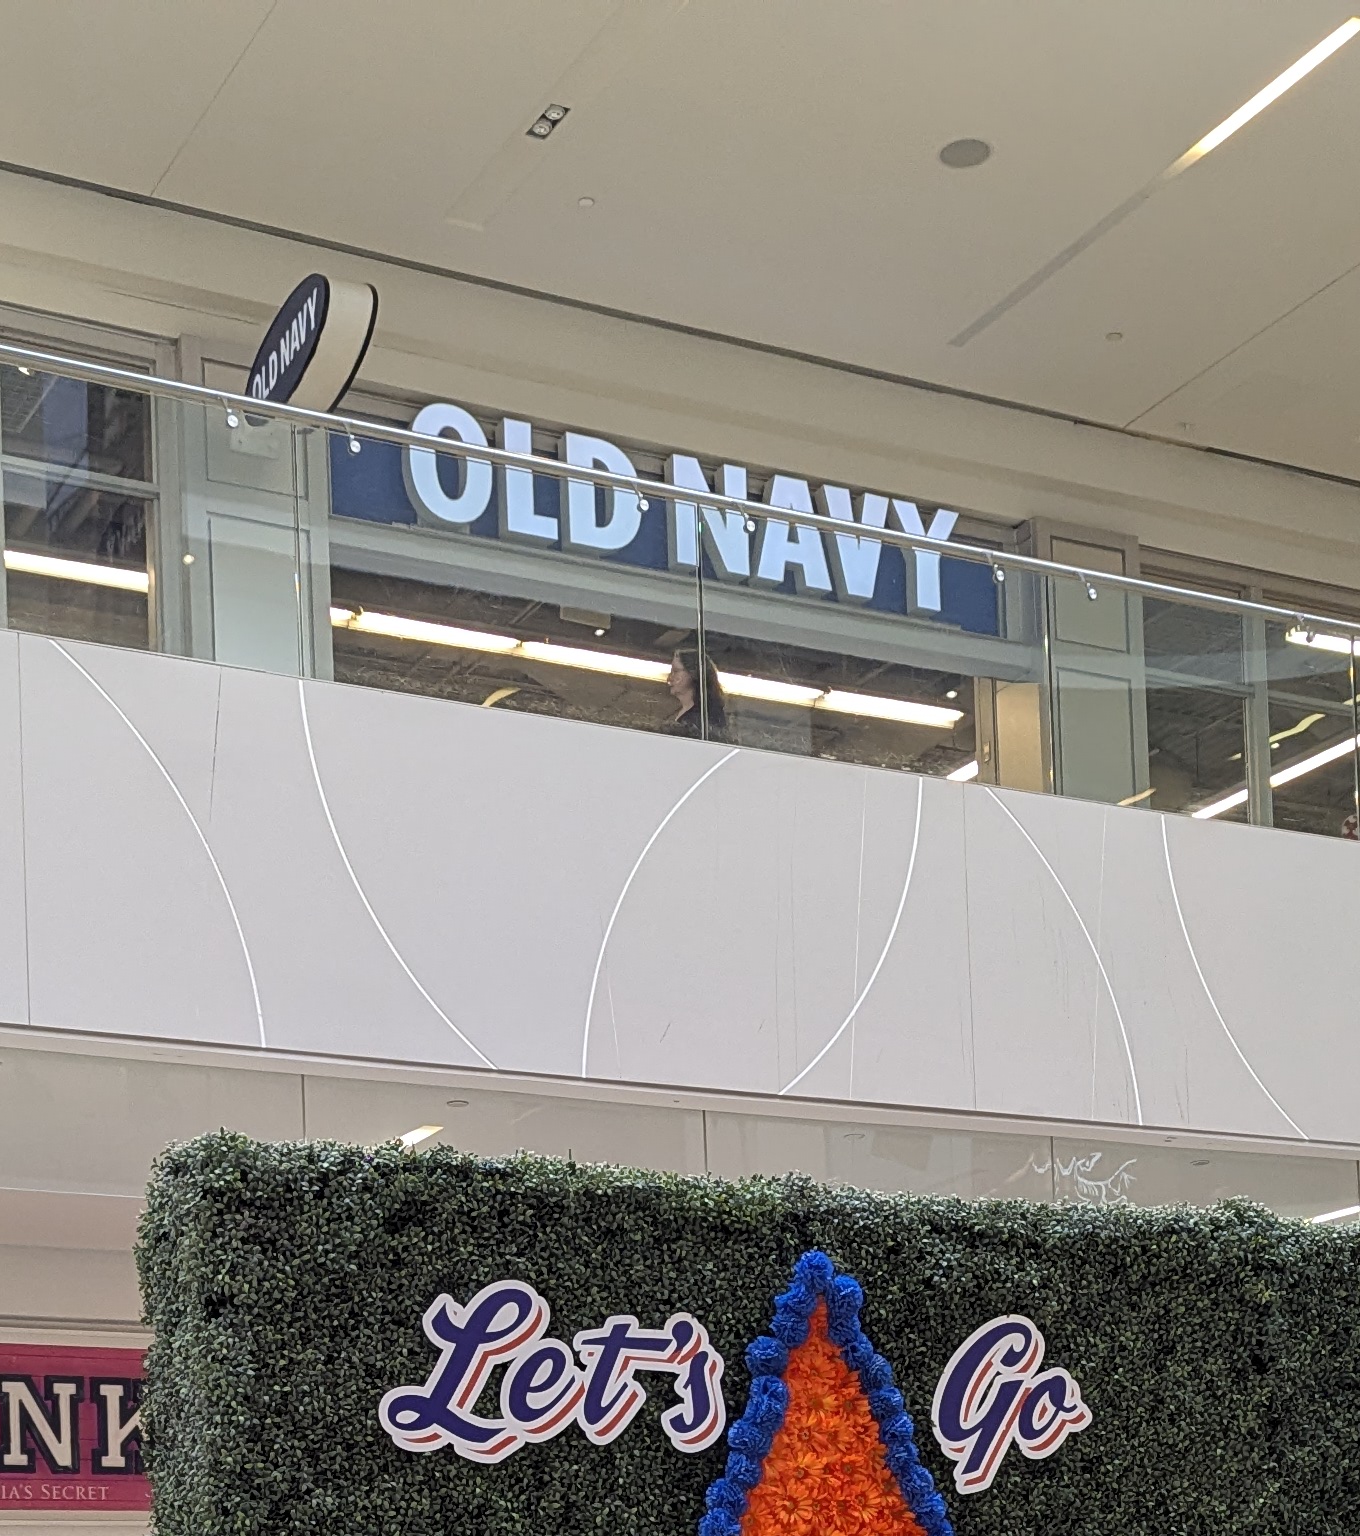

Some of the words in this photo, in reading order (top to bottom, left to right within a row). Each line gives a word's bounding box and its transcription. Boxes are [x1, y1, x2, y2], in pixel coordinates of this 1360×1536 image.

[252, 351, 277, 400] OLD
[280, 287, 318, 374] NAVY
[406, 402, 642, 550] OLD
[670, 454, 959, 613] NAVY
[382, 1282, 723, 1462] Let's
[935, 1316, 1090, 1492] Go
[41, 1484, 109, 1500] SECRET
